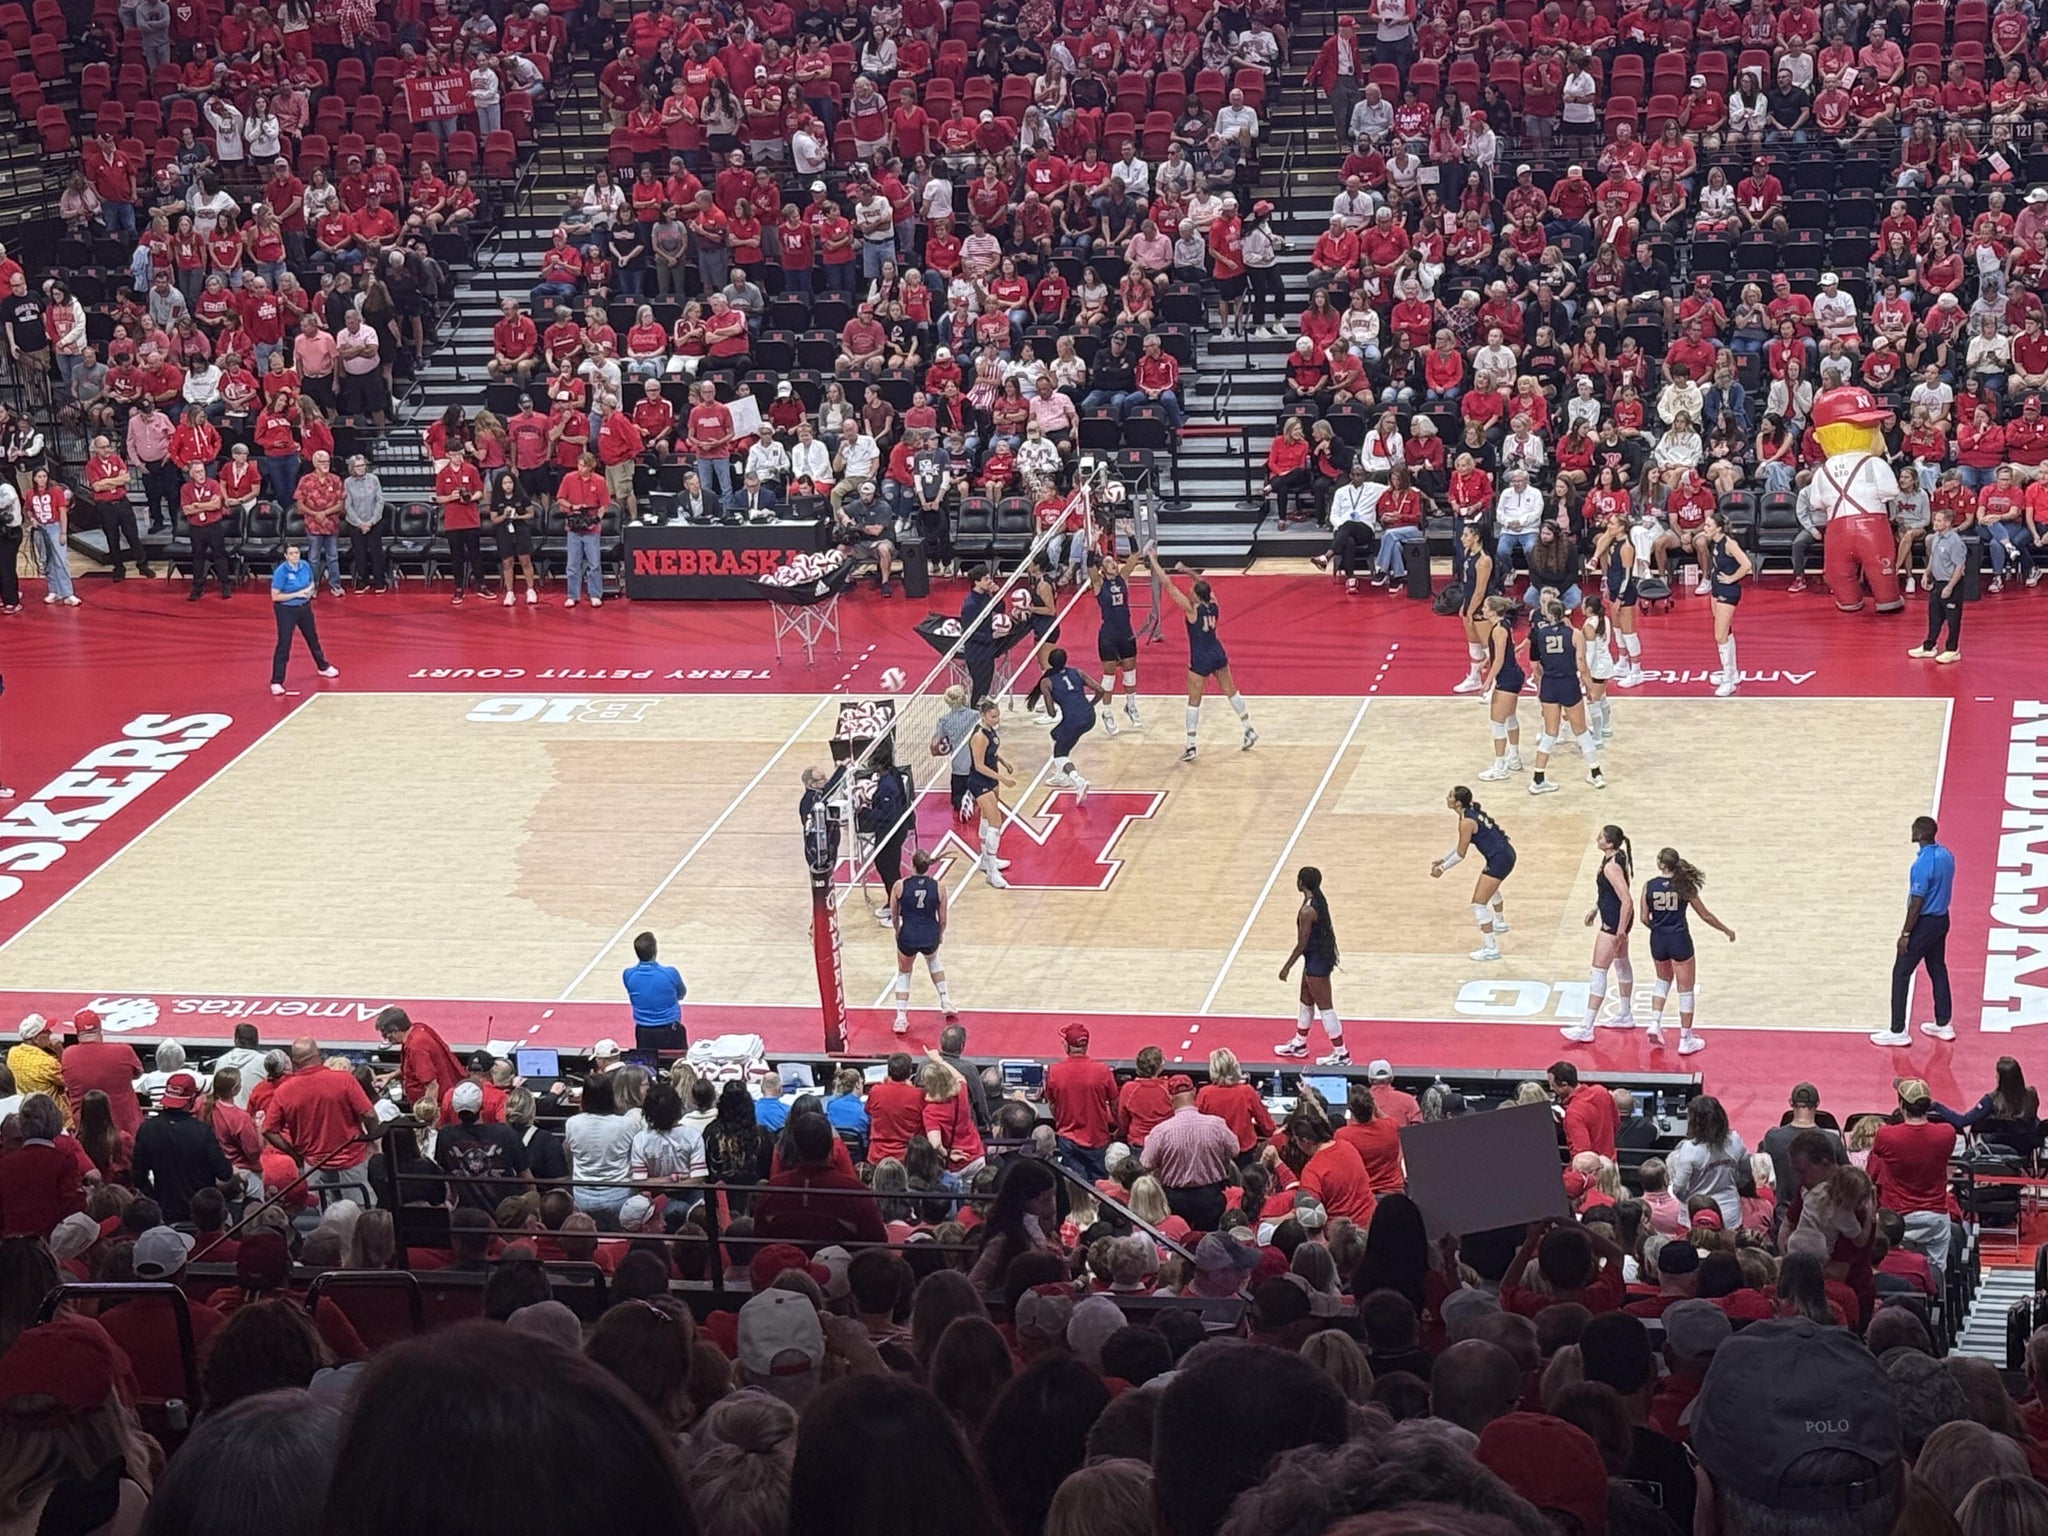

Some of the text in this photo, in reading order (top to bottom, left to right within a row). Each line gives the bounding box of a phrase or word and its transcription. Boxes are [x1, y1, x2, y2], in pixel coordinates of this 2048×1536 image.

[432, 90, 451, 105] N
[1824, 103, 1839, 117] N
[2015, 124, 2032, 137] 121
[618, 167, 635, 180] 119
[1035, 169, 1051, 183] N
[1749, 195, 1764, 212] N
[788, 234, 802, 248] N
[182, 244, 192, 257] N
[1363, 277, 1381, 297] N
[1856, 395, 1870, 408] N
[1111, 594, 1124, 607] 13
[1545, 635, 1564, 654] 21
[407, 667, 773, 680] TERRY PETTIT COURT
[1062, 675, 1075, 690] 1
[914, 889, 927, 909] 7
[1652, 891, 1679, 911] 20
[1804, 1419, 1850, 1434] POLO
